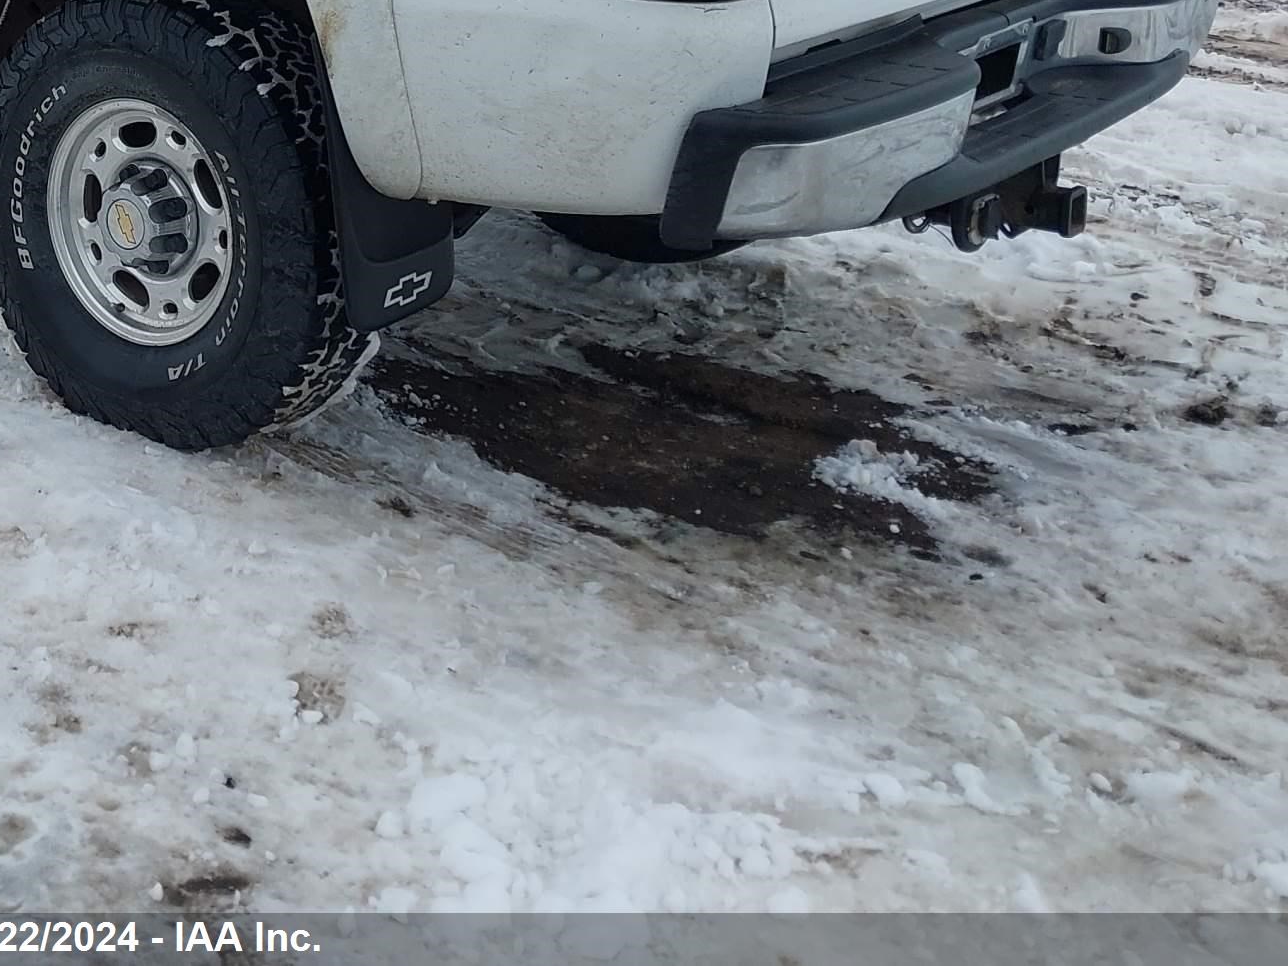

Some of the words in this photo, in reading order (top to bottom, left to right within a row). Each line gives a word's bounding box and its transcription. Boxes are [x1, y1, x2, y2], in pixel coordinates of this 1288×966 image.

[10, 83, 67, 270] BFGoodrich
[214, 149, 248, 346] All-Terrain
[168, 351, 207, 381] T/A
